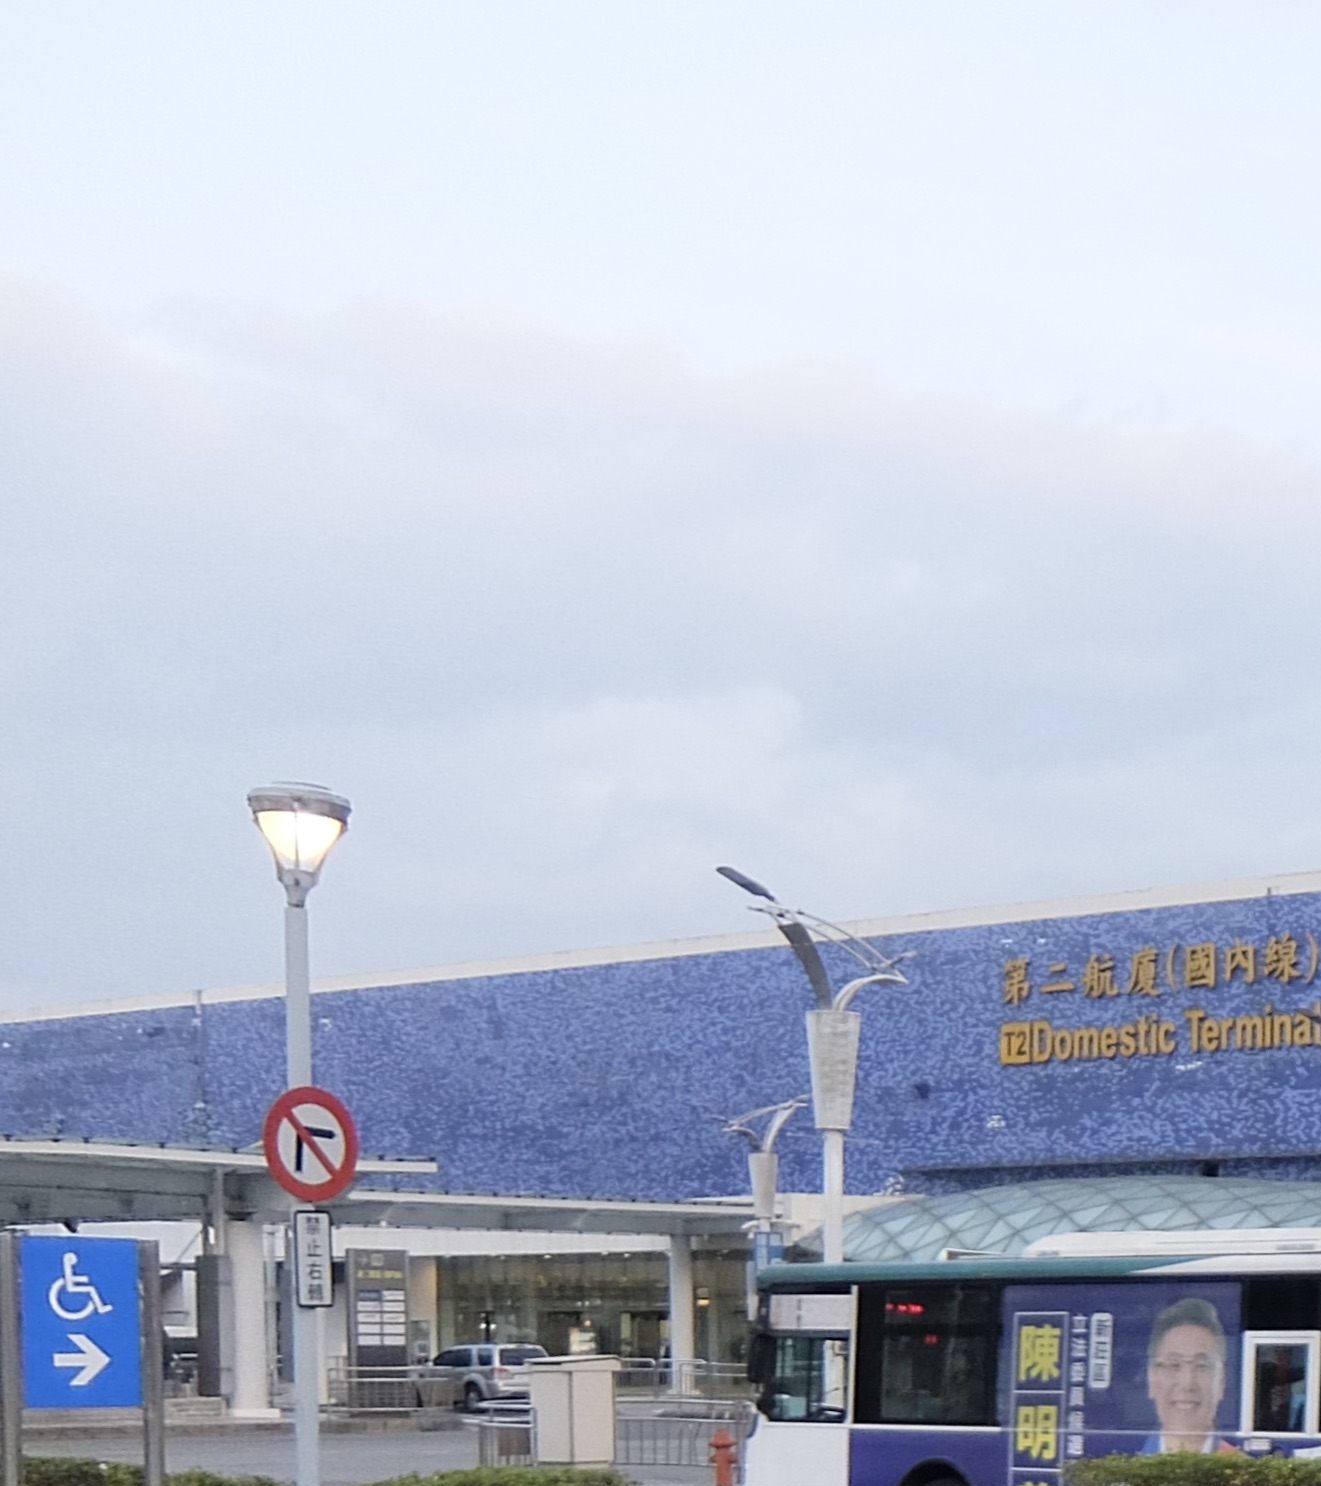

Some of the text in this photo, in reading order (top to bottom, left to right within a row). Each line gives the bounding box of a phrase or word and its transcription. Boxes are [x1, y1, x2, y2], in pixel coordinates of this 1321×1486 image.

[1003, 931, 1320, 1007] 第二航廈(國內線)
[1002, 1028, 1029, 1058] T2
[1031, 1014, 1177, 1062] Domestic
